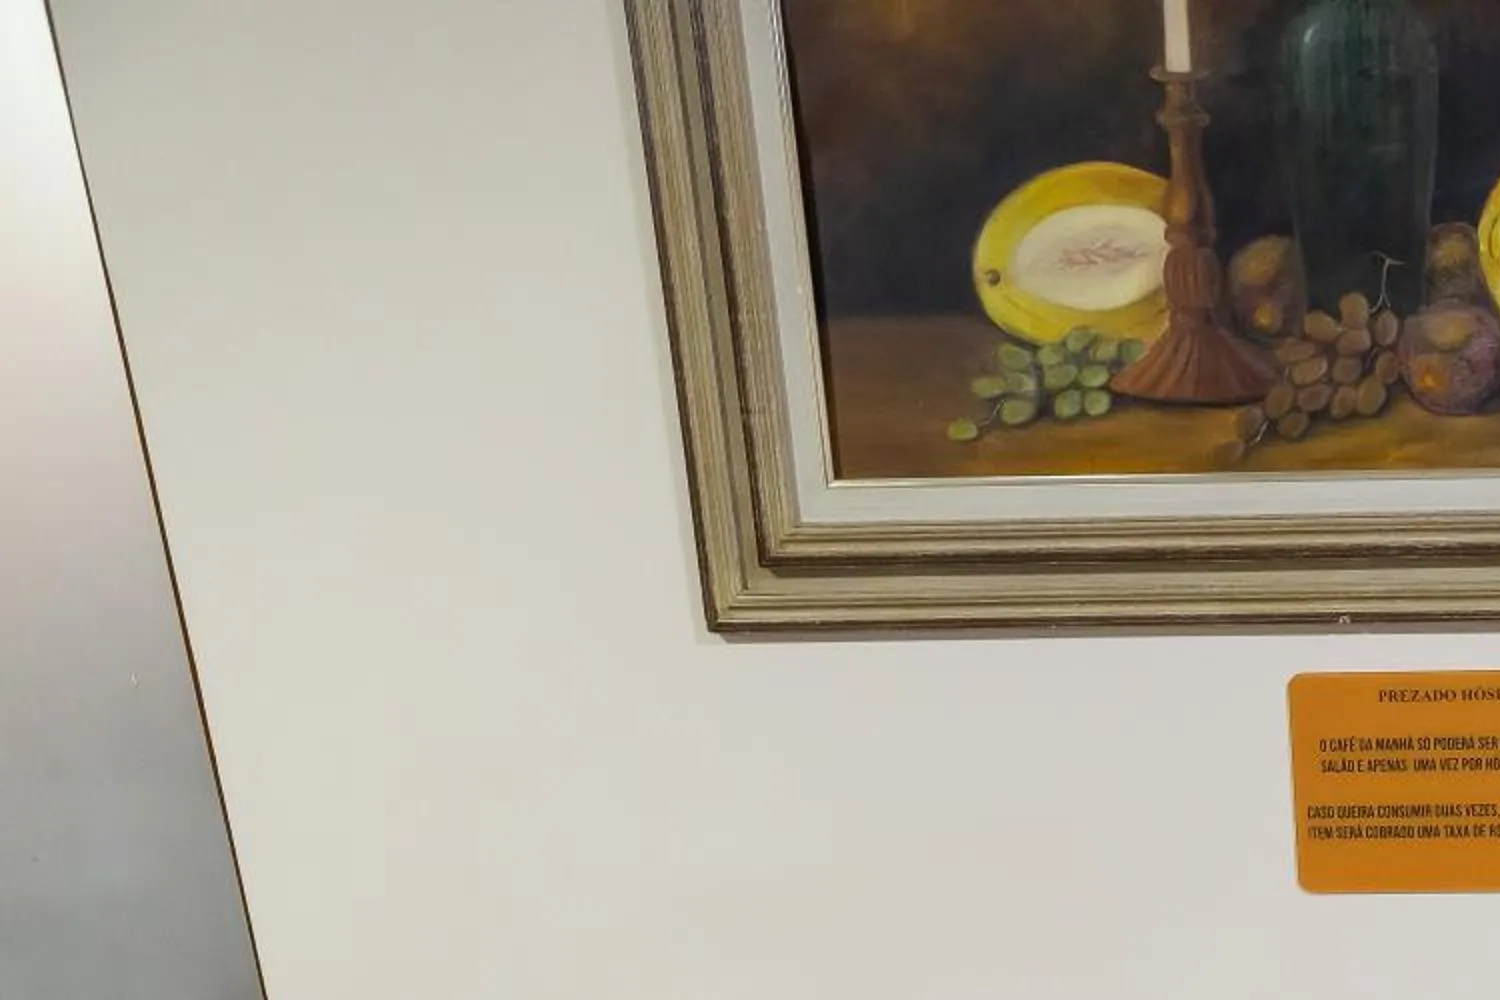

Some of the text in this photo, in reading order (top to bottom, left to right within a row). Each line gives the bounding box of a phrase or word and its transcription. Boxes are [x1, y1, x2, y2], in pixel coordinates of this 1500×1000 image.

[1379, 688, 1457, 703] PREZADO
[1320, 738, 1327, 752] O
[1329, 735, 1355, 752] CAFÉ
[1478, 735, 1499, 750] SER
[1357, 759, 1364, 772] E
[1413, 757, 1437, 771] UMA
[1439, 757, 1459, 771] VEZ
[1461, 757, 1483, 770] POR
[1307, 805, 1334, 818] CASO
[1337, 804, 1375, 818] QUEIRA
[1377, 804, 1432, 818] CONSUMIR
[1435, 803, 1462, 817] DUAS
[1365, 825, 1415, 838] COBRADO
[1417, 824, 1441, 838] UMA
[1443, 824, 1471, 838] TAXA
[1473, 824, 1486, 837] DE
